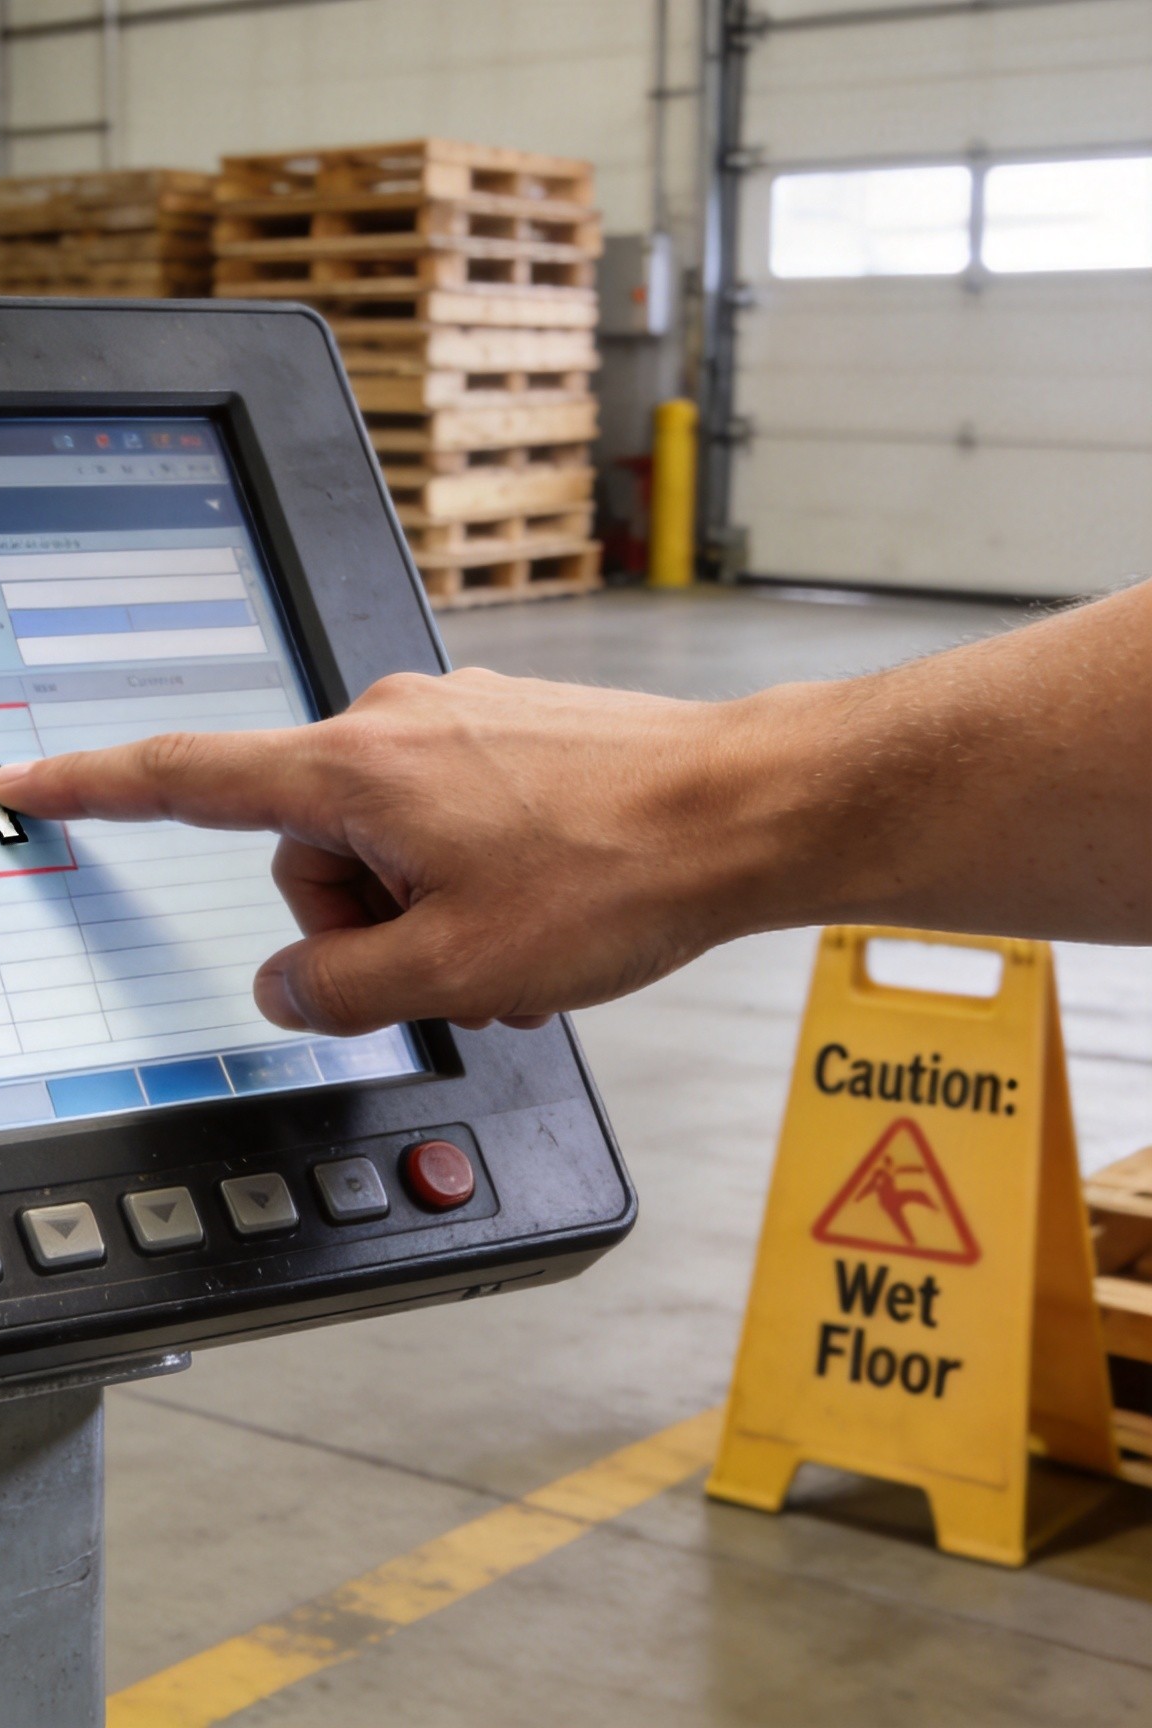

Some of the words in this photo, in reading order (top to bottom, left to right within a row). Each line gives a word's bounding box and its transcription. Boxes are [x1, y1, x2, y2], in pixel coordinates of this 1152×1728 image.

[814, 1043, 1018, 1116] Caution:
[835, 1260, 940, 1328] Wet
[815, 1323, 962, 1398] Floor
